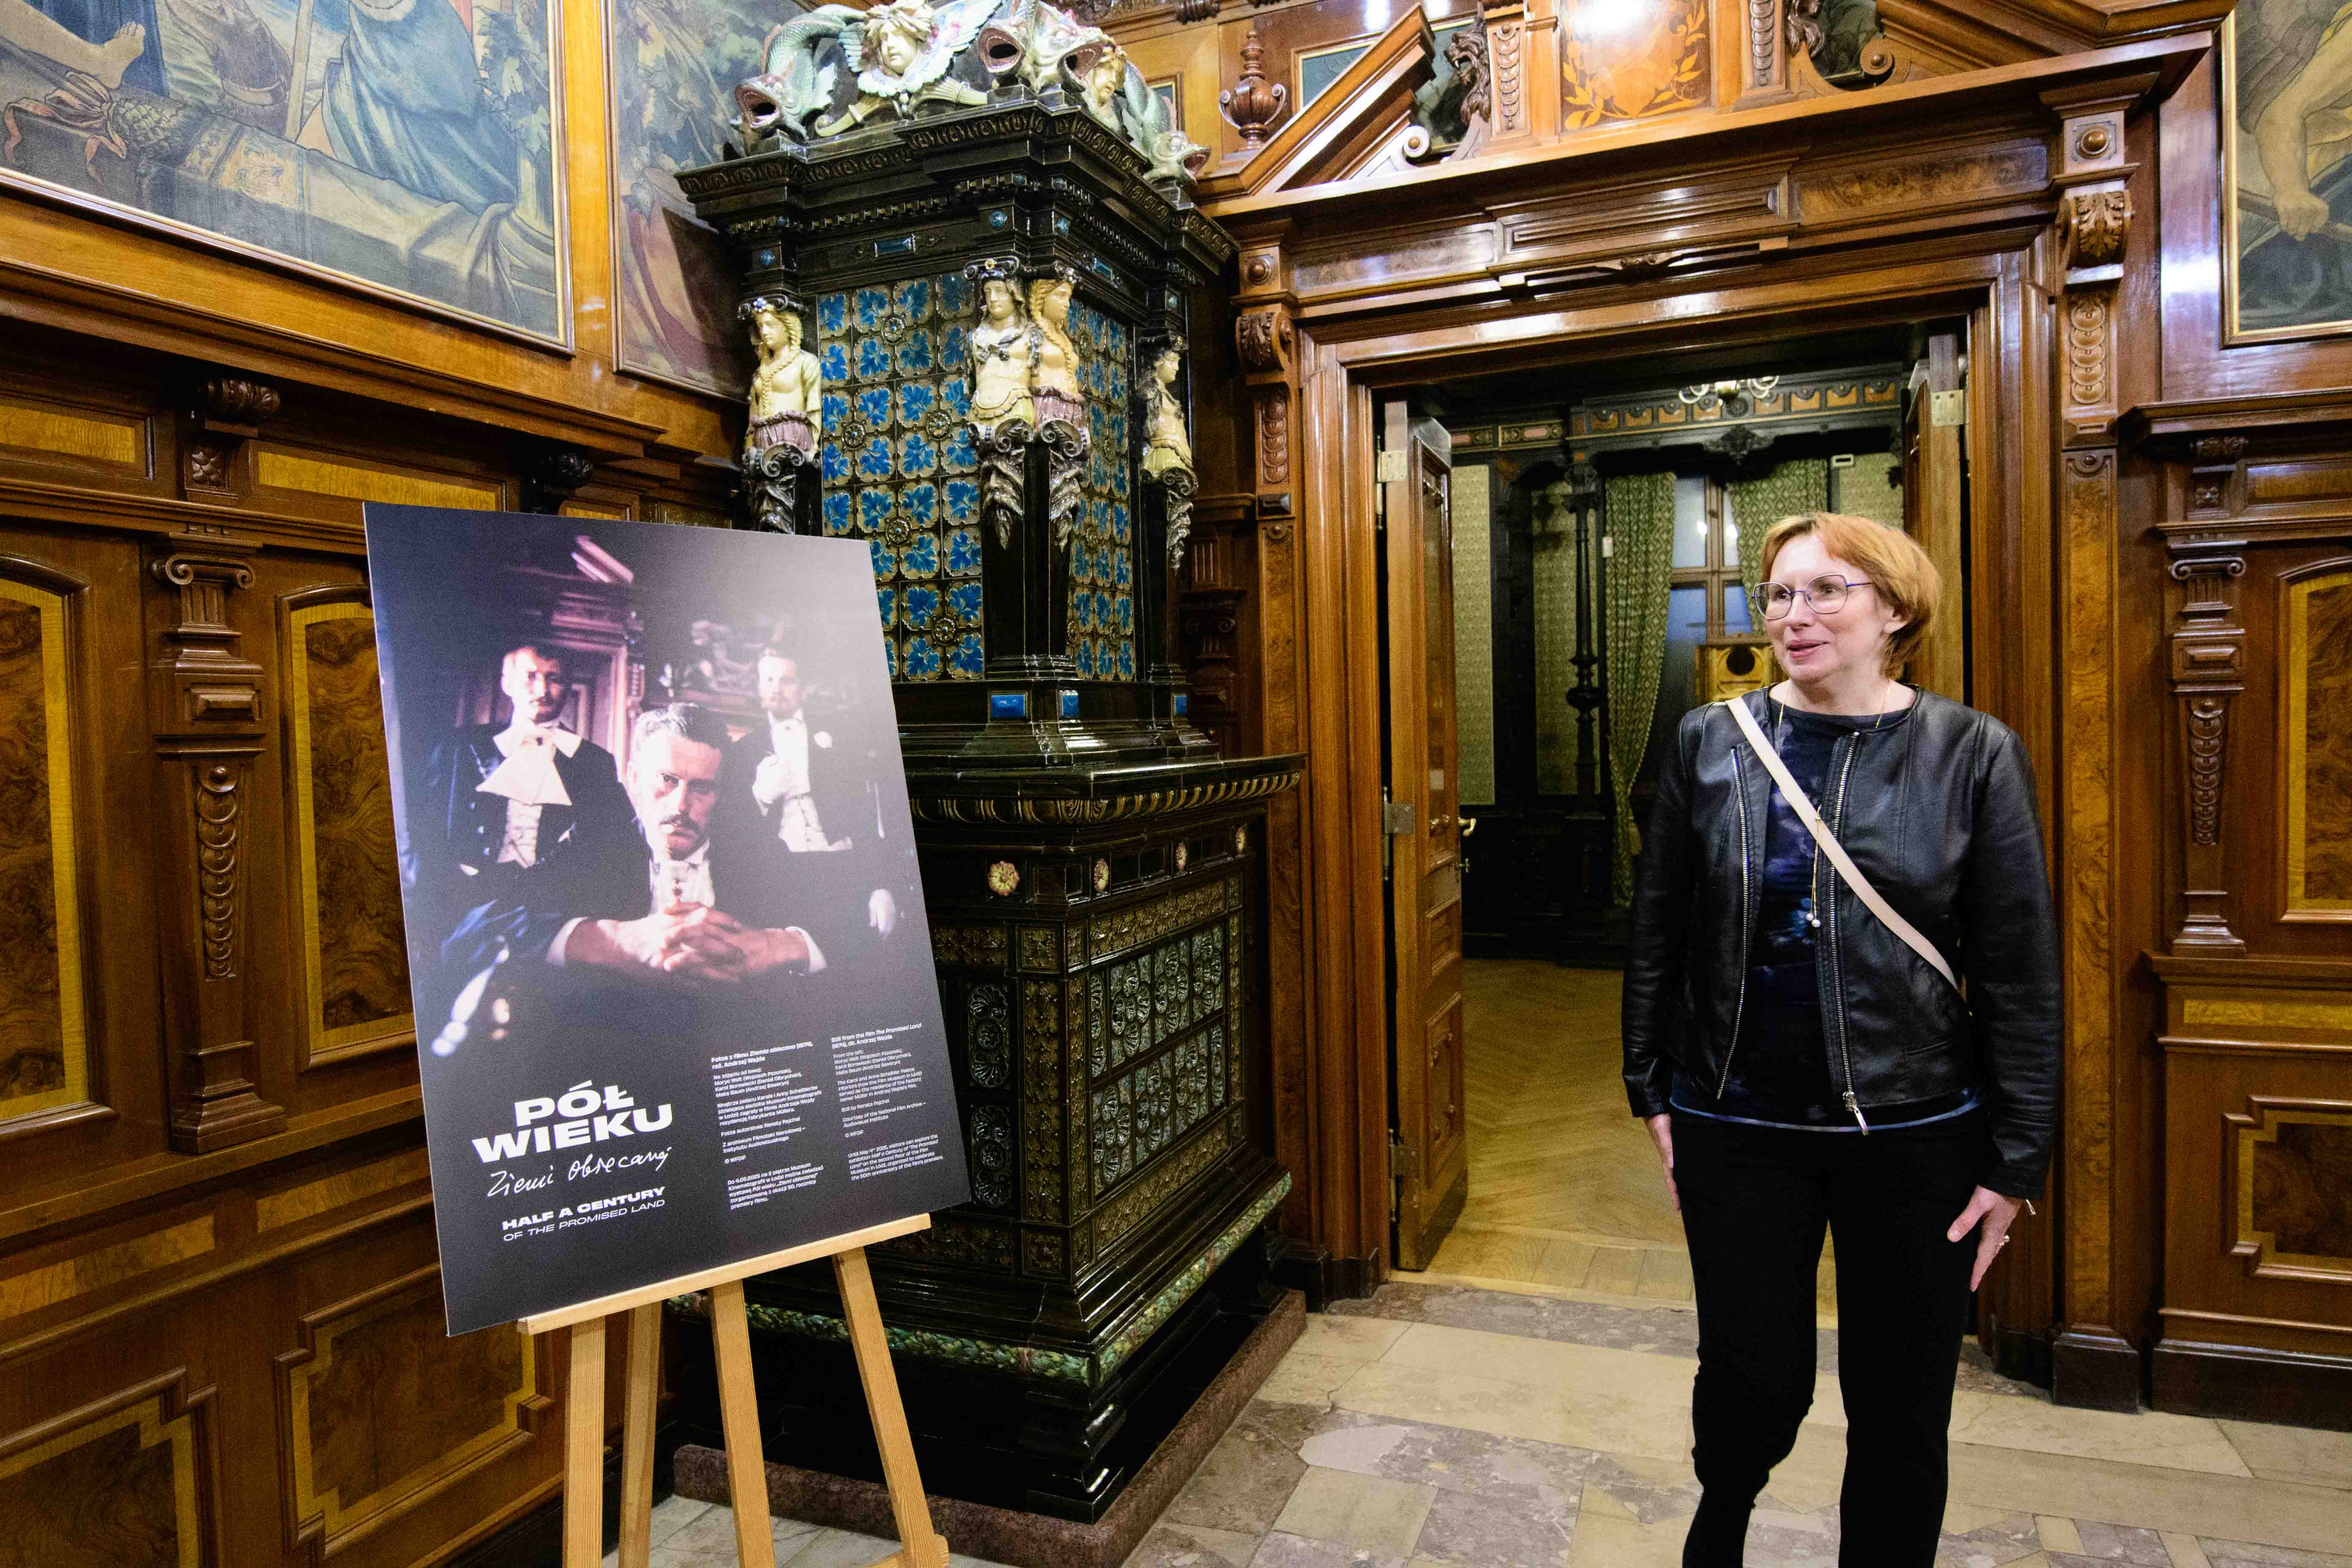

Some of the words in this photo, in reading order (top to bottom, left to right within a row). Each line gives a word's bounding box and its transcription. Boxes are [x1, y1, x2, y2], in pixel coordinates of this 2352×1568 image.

[514, 1080, 634, 1127] PÓŁ
[471, 1103, 672, 1163] WIEKU
[487, 1165, 554, 1197] Ziemi
[502, 1211, 554, 1230] HALF
[558, 1207, 573, 1217] A
[577, 1187, 665, 1213] CENTURY
[503, 1231, 523, 1241] OF
[527, 1223, 555, 1236] THE
[559, 1208, 627, 1229] PROMISED
[631, 1199, 665, 1213] LAND
